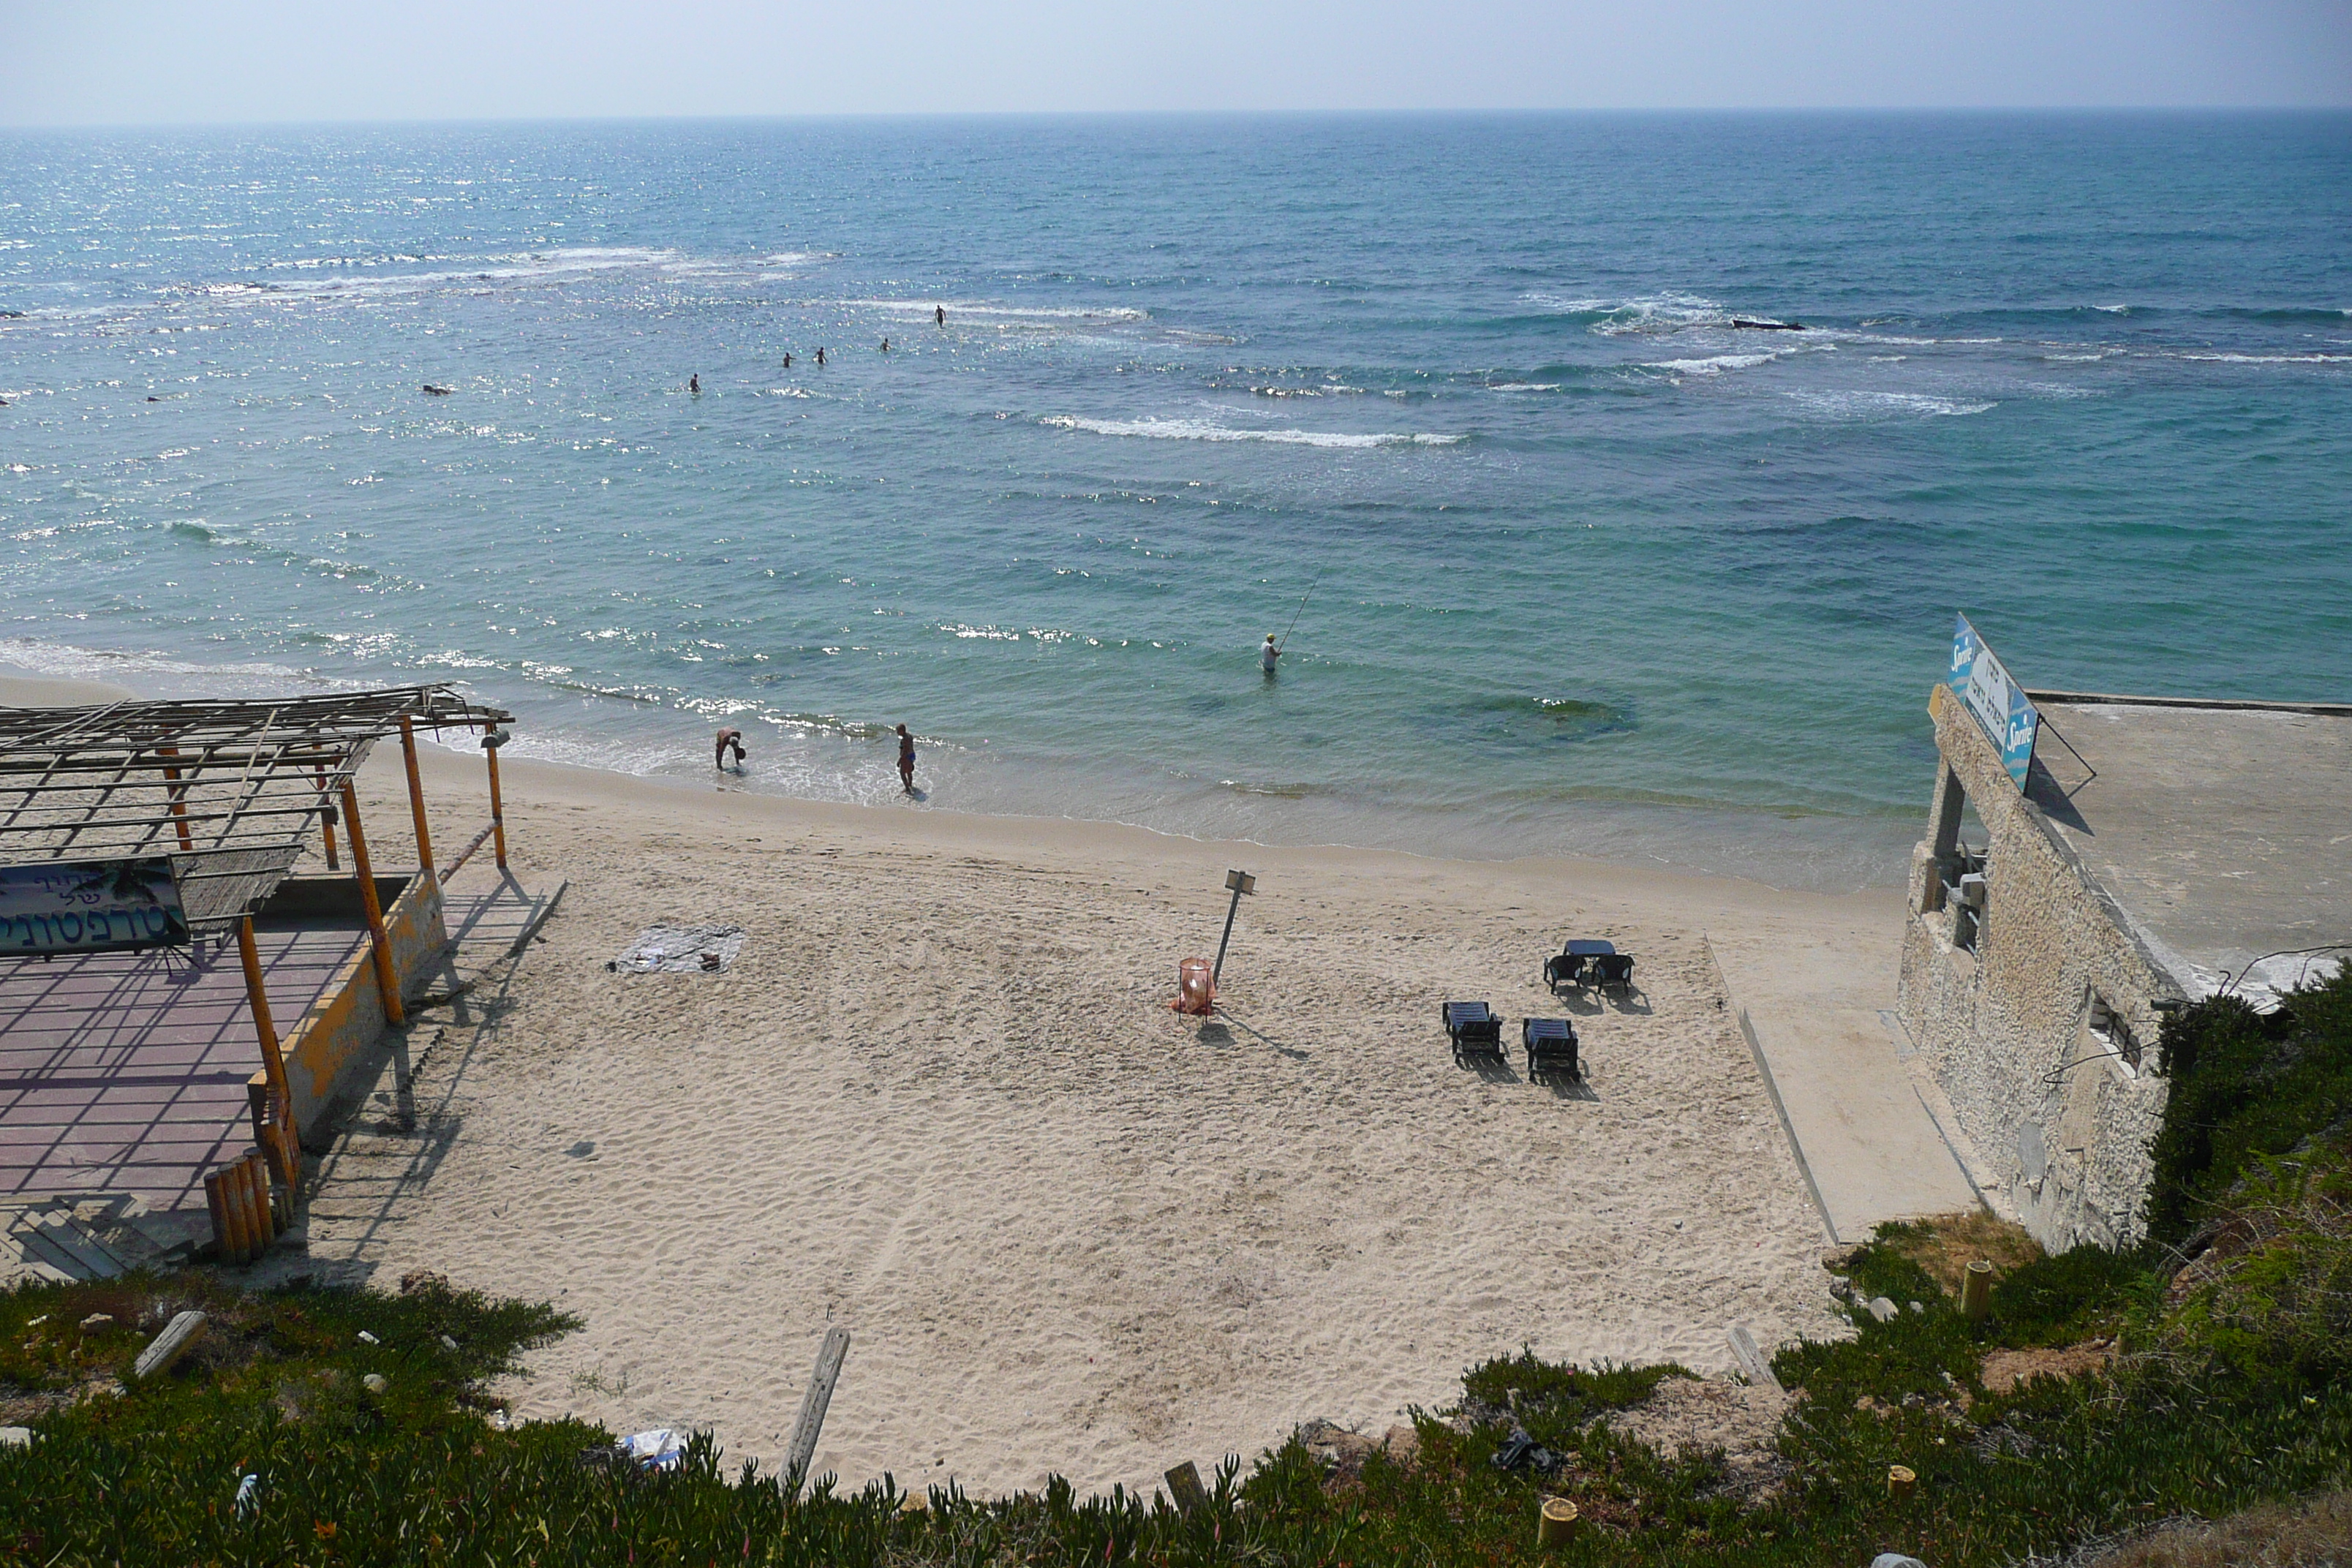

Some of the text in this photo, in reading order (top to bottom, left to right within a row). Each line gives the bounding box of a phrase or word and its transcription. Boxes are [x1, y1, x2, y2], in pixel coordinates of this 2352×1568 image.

[1951, 636, 1972, 673] Sprite
[2007, 714, 2033, 753] Sprite
[59, 892, 101, 906] של
